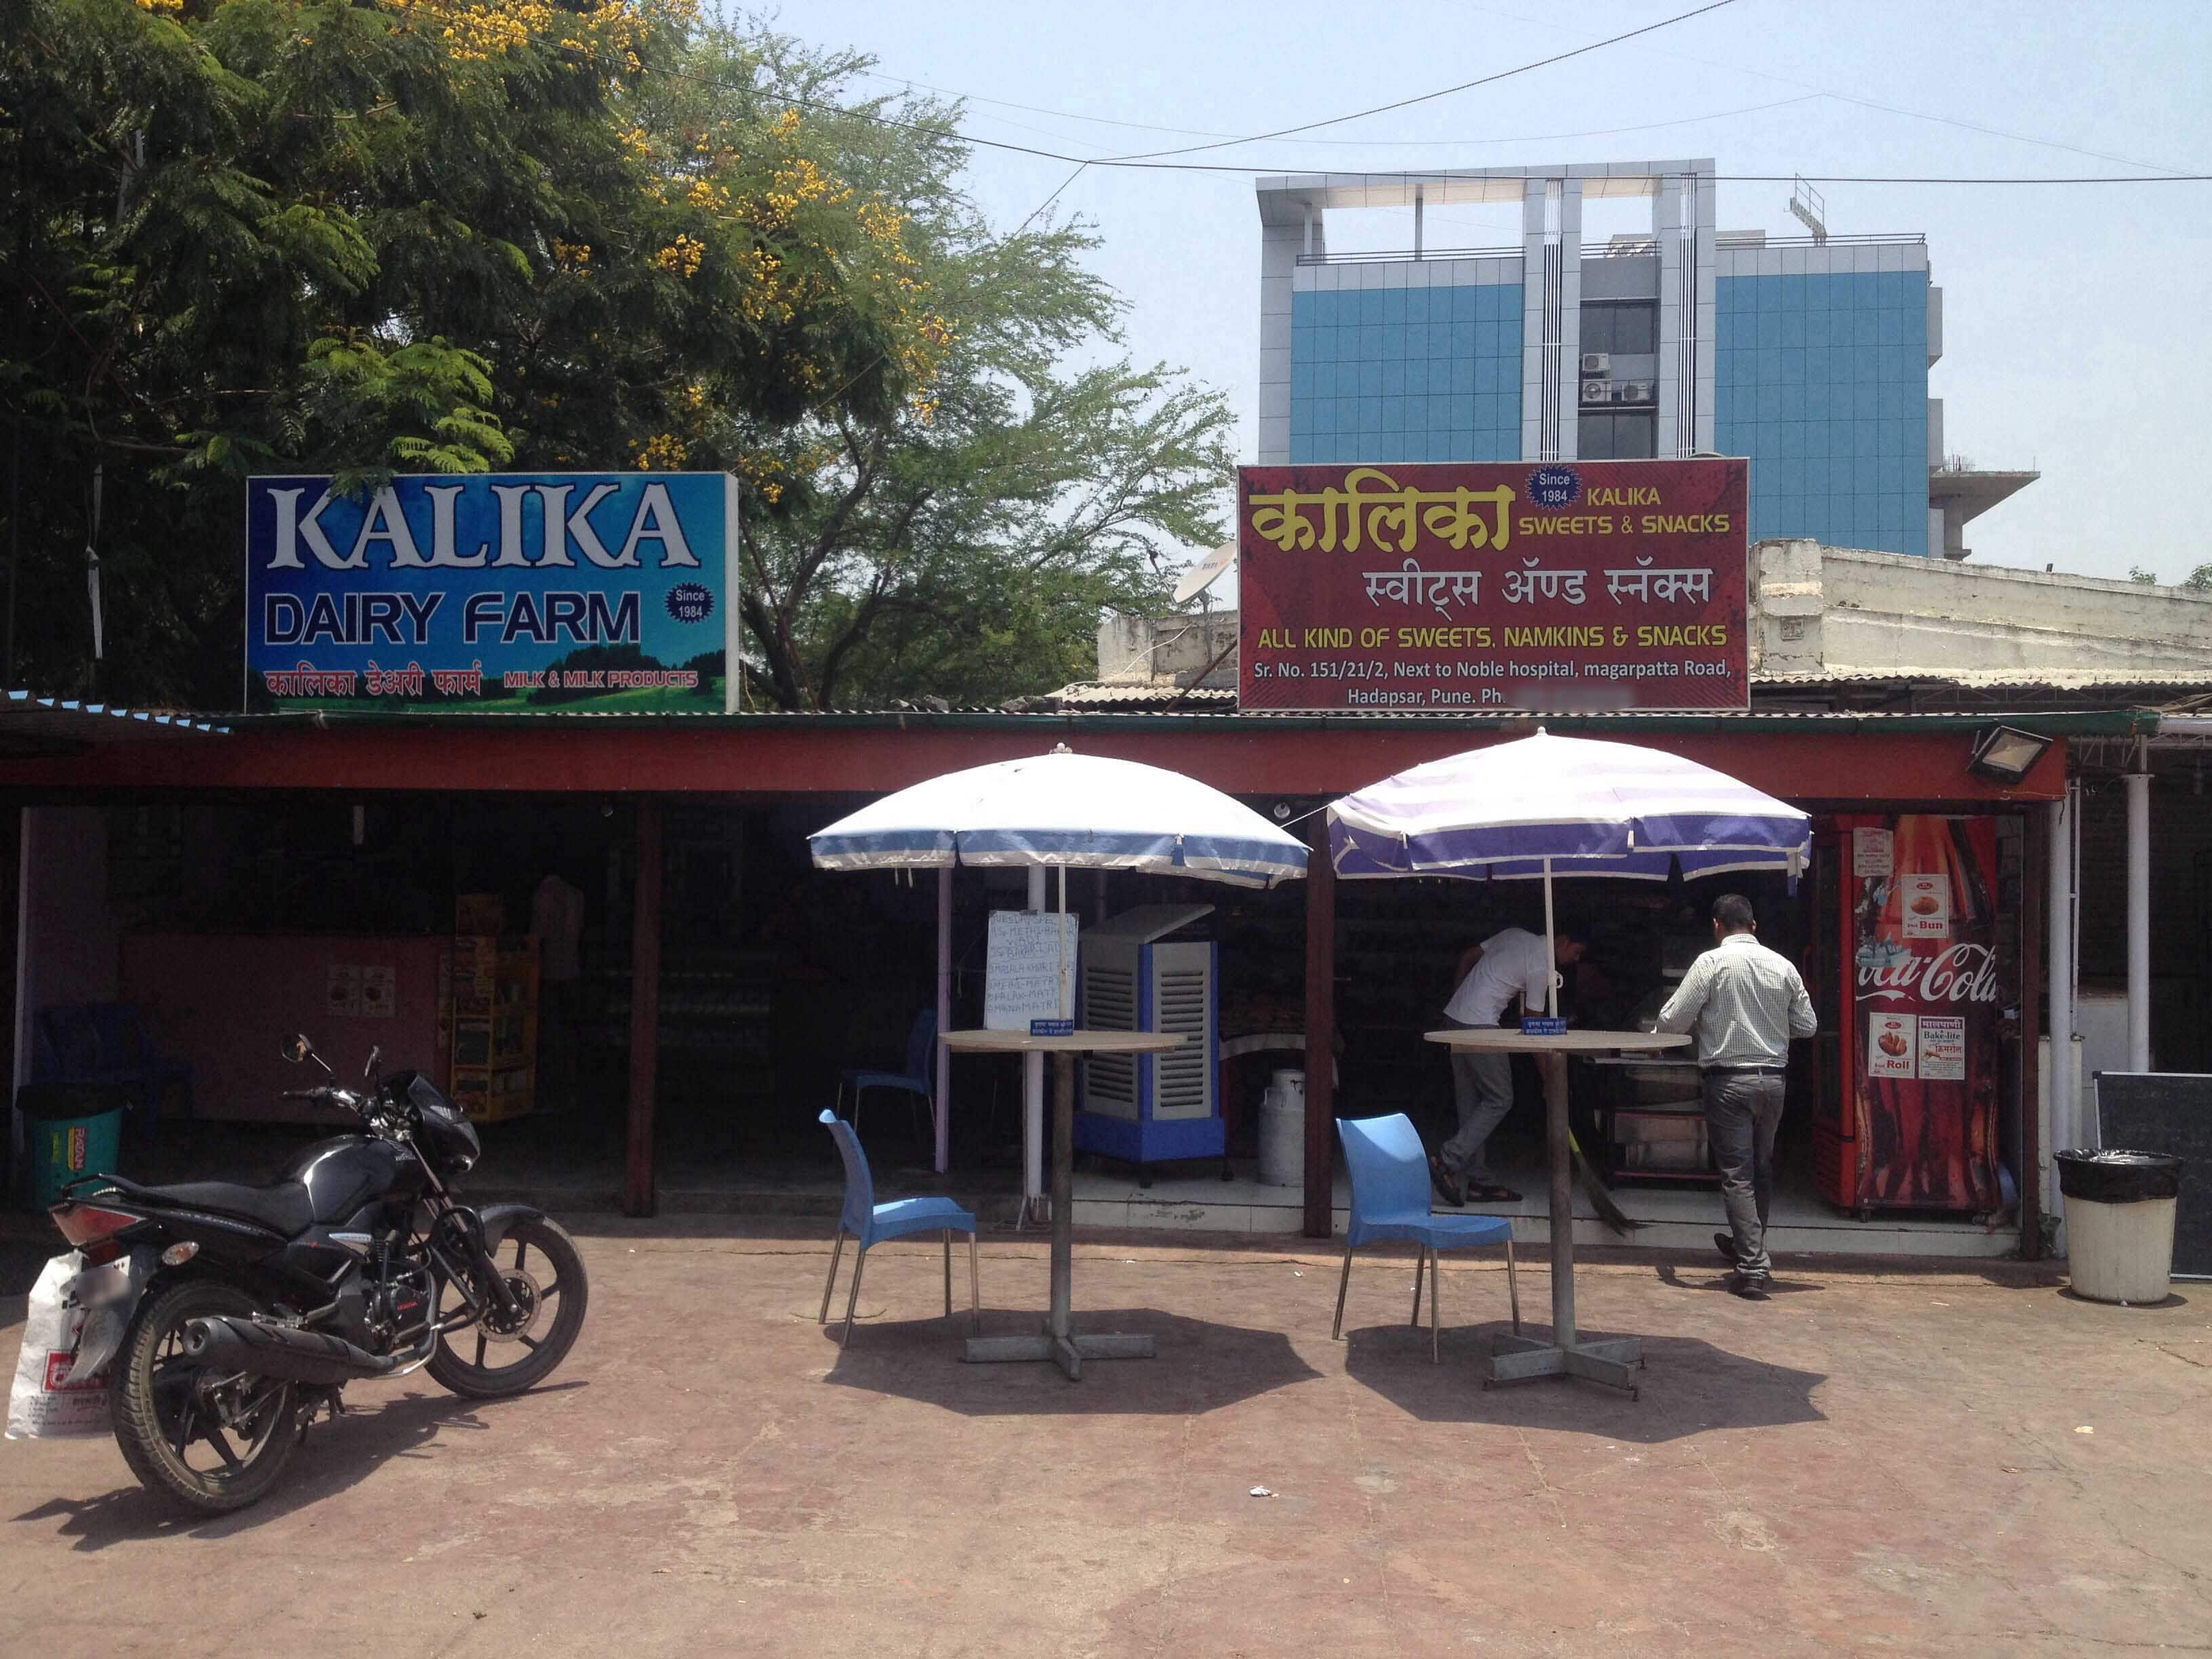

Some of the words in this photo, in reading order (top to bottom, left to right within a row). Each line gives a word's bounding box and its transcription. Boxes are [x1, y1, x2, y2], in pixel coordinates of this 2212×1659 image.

[1539, 473, 1570, 485] Since
[1542, 490, 1568, 502] 1984
[1587, 487, 1661, 506] KALIKA
[1248, 468, 1515, 552] कालिका
[266, 481, 701, 570] KALIKA
[1519, 516, 1613, 535] SWEETS
[1621, 517, 1633, 534] &
[1641, 514, 1729, 533] SNACKS
[676, 589, 705, 602] Since
[1363, 558, 1483, 621] स्वीट्स
[264, 592, 445, 644] DAIRY
[463, 592, 642, 644] FARM
[678, 605, 703, 619] 1984
[1258, 629, 1296, 649] ALL
[1304, 628, 1353, 649] KIND
[1360, 628, 1389, 648] OF
[1504, 626, 1605, 647] NAMKINS
[1612, 625, 1629, 646] &
[1637, 625, 1727, 647] SNACKS
[264, 661, 357, 697] कालिका
[366, 661, 424, 697] डेअरी
[431, 661, 482, 697] फार्म
[504, 671, 544, 688] MILK
[548, 672, 560, 687] &
[563, 671, 604, 688] MILK
[608, 670, 698, 688] PRODUCTS
[1254, 663, 1273, 678] Sr.
[1277, 663, 1306, 678] No.
[1310, 661, 1389, 680] 151/21/2,
[1393, 662, 1431, 677] Next
[1435, 663, 1452, 677] to
[1456, 661, 1505, 677] Noble
[1509, 660, 1580, 681] hospital,
[1584, 662, 1679, 681] magarpatta
[1684, 659, 1732, 679] Road,
[1347, 688, 1426, 708] Hadapsar,
[1431, 689, 1477, 705] Pune.
[1481, 689, 1506, 705] Ph.
[1919, 921, 1943, 929] Bun
[1887, 1060, 1909, 1069] Roll
